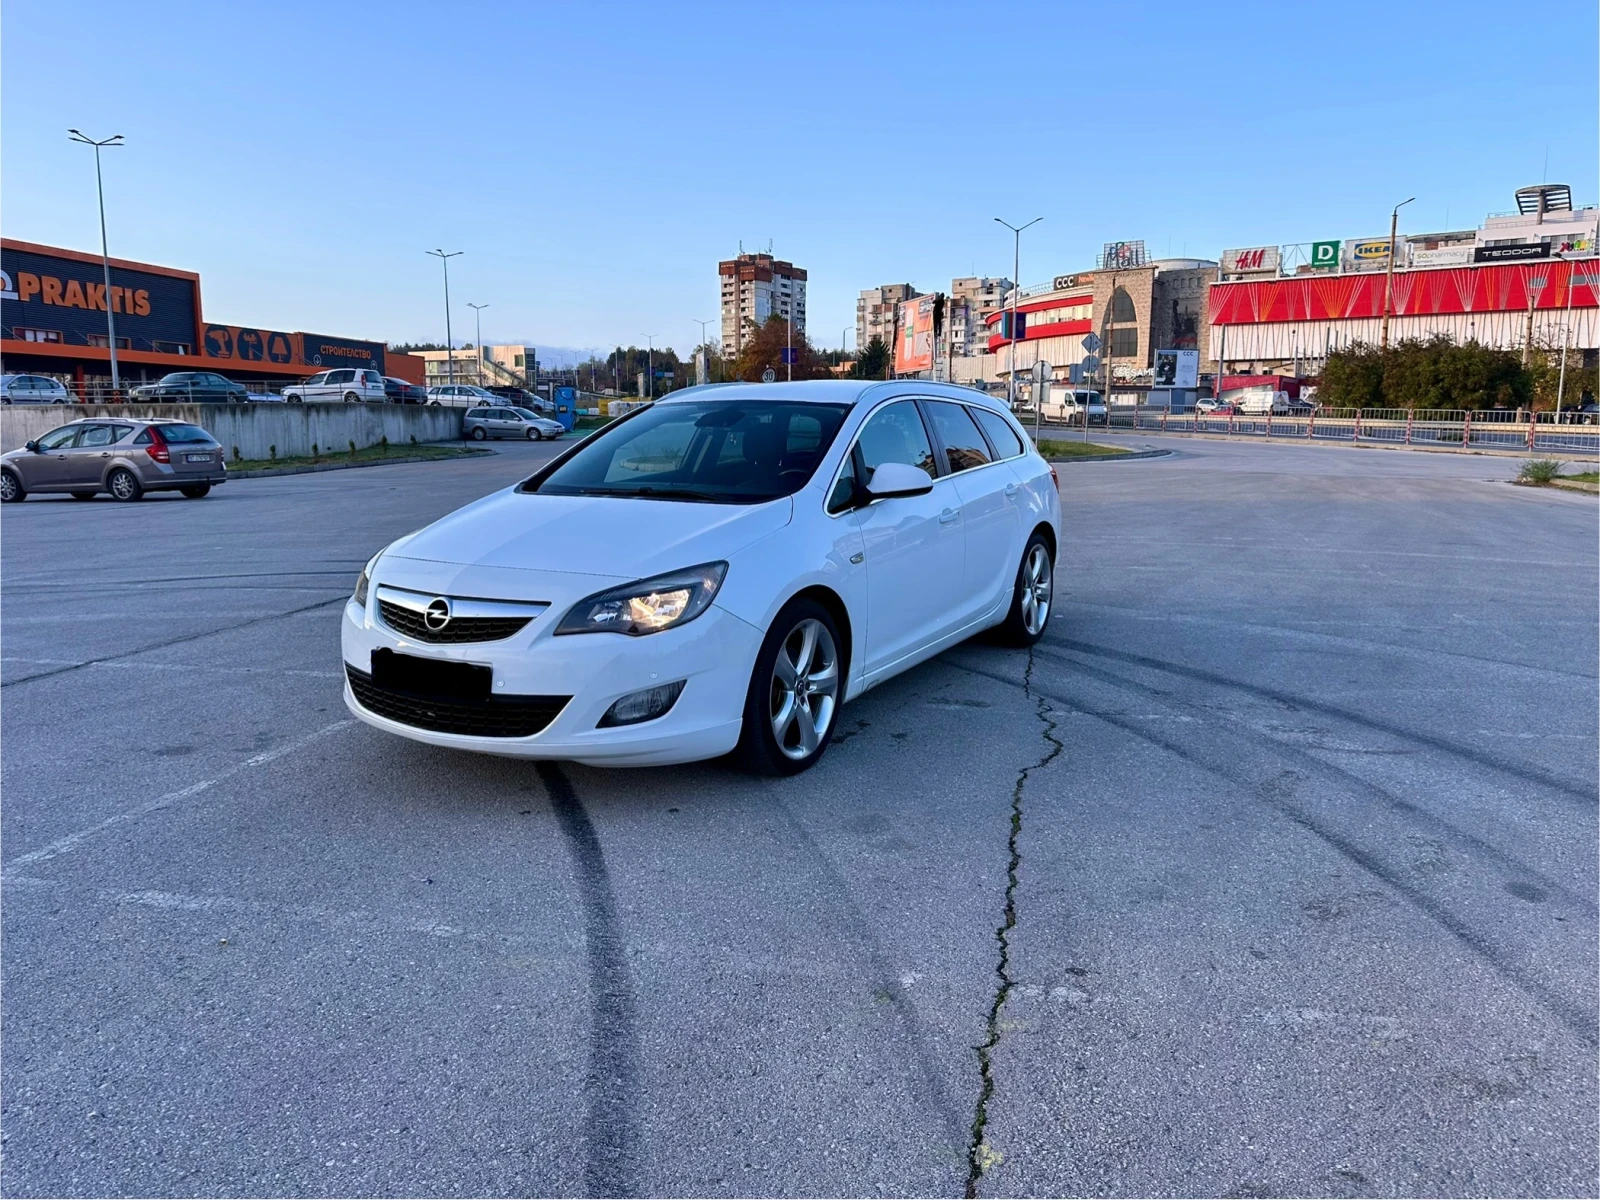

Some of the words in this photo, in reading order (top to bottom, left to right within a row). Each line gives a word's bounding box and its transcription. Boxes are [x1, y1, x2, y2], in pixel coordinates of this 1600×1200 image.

[1317, 245, 1334, 260] D
[1482, 247, 1542, 257] TEODOR
[1235, 249, 1265, 270] H&M
[1056, 276, 1074, 288] CCC
[18, 272, 151, 316] PRAKTIS
[320, 345, 371, 359] СТРОИТЕЛСТВО
[764, 371, 773, 381] 30
